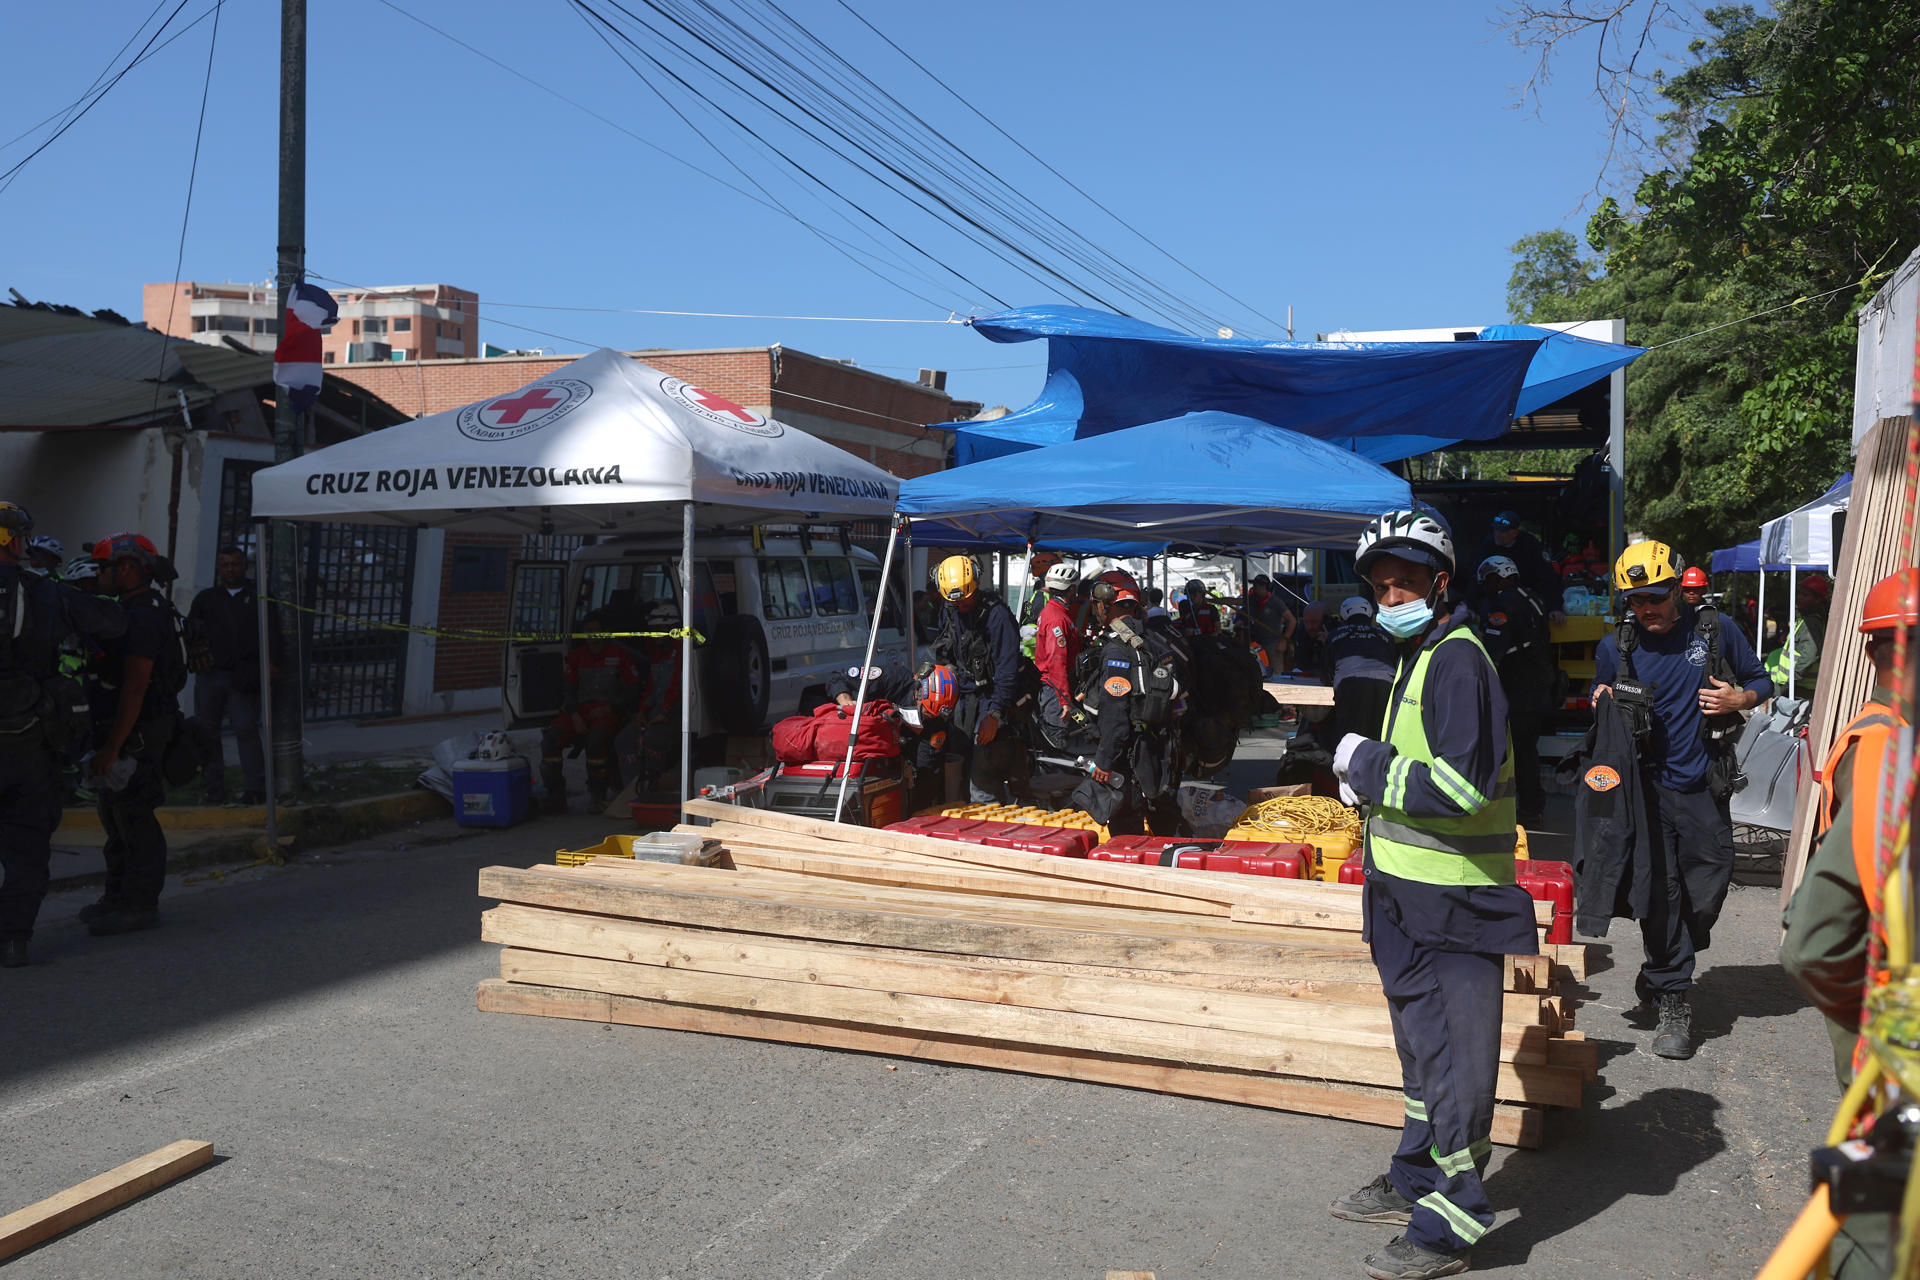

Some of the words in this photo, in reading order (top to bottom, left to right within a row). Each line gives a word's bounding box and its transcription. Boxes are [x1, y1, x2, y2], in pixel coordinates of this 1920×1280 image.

[306, 472, 370, 495] CRUZ
[376, 468, 439, 497] ROJA
[446, 464, 623, 489] VENEZOLANA
[730, 467, 772, 488] CRUZ
[770, 471, 806, 498] ROJA
[808, 472, 889, 500] VENEZOLANA
[771, 623, 792, 640] CRUZ
[793, 623, 813, 638] ROJA
